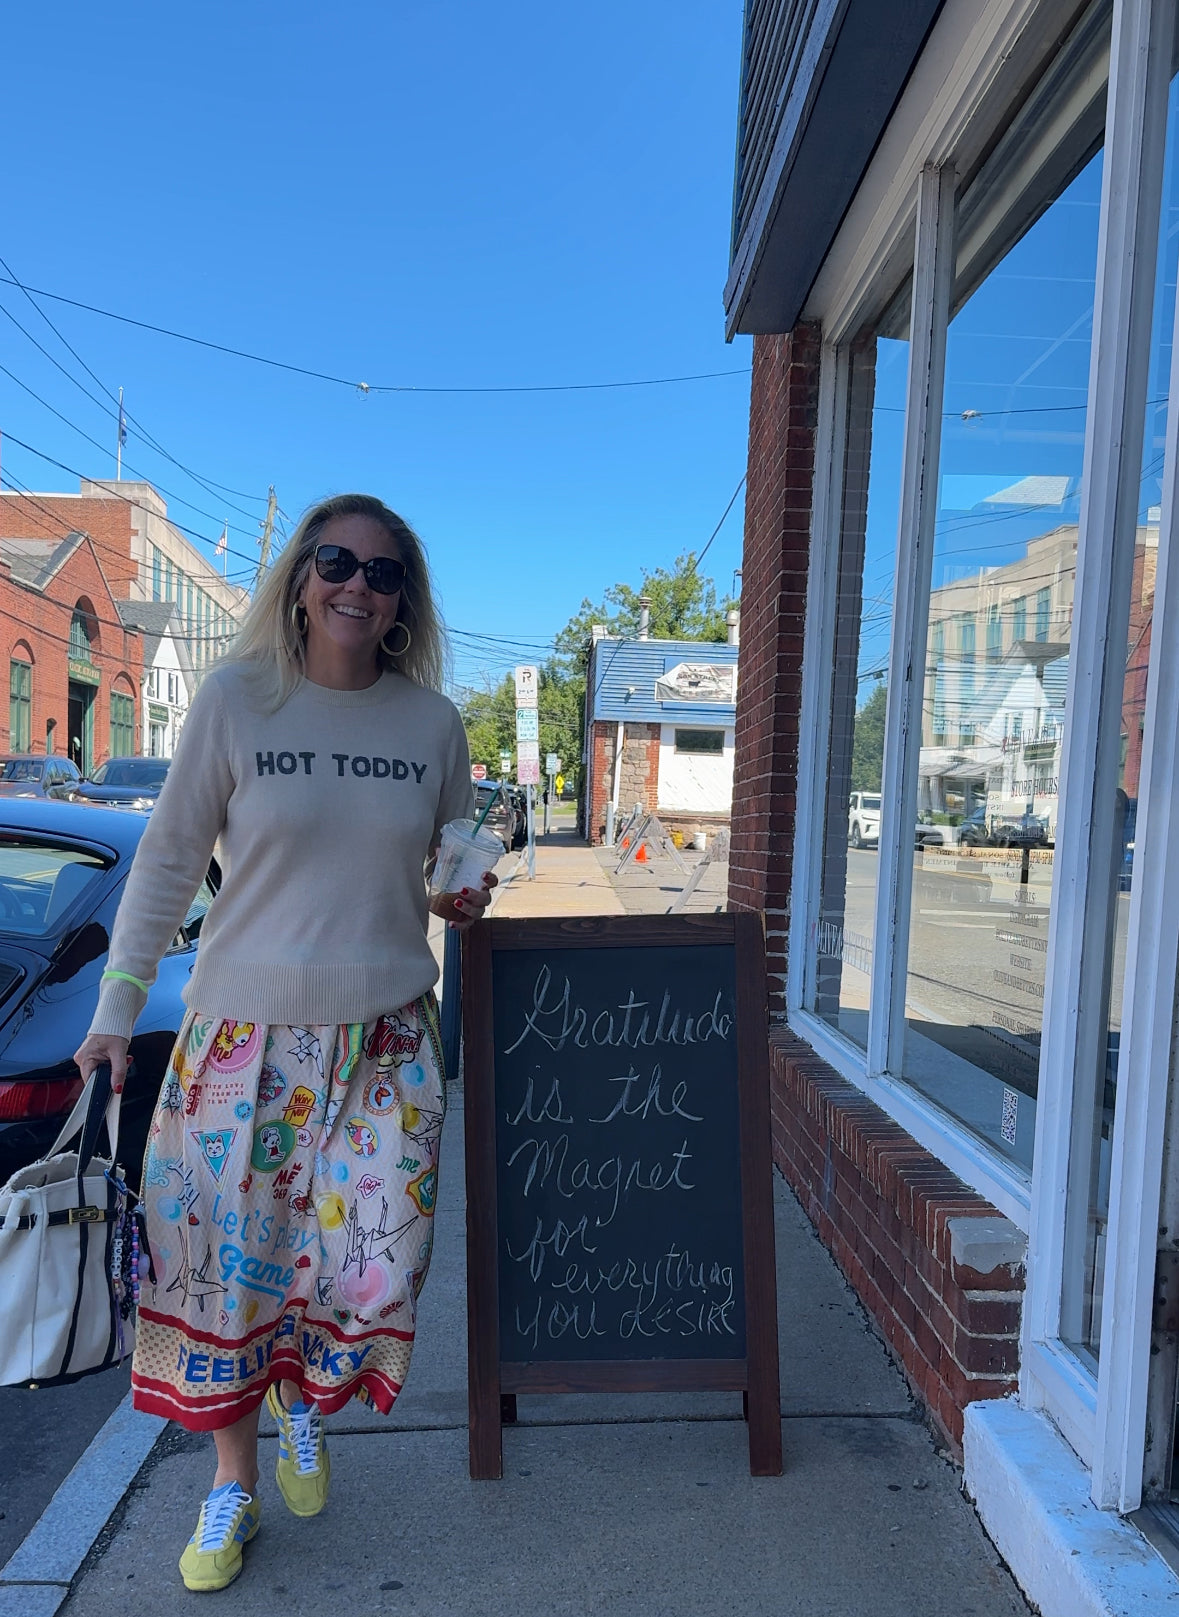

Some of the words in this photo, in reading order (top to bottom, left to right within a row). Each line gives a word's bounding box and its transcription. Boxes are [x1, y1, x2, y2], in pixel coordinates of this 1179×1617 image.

[256, 751, 315, 776] HOT
[332, 753, 427, 784] TODDY
[1010, 779, 1032, 797] STORE
[1033, 776, 1058, 795] HOURS
[506, 1065, 574, 1125] is
[588, 1063, 704, 1123] the
[273, 1188, 289, 1200] 369
[506, 1133, 696, 1227] Magnet
[211, 1194, 275, 1243] Let's
[270, 1219, 317, 1256] play
[506, 1215, 597, 1283] for
[217, 1243, 295, 1288] Game
[552, 1242, 734, 1312] everything
[516, 1297, 607, 1350] you
